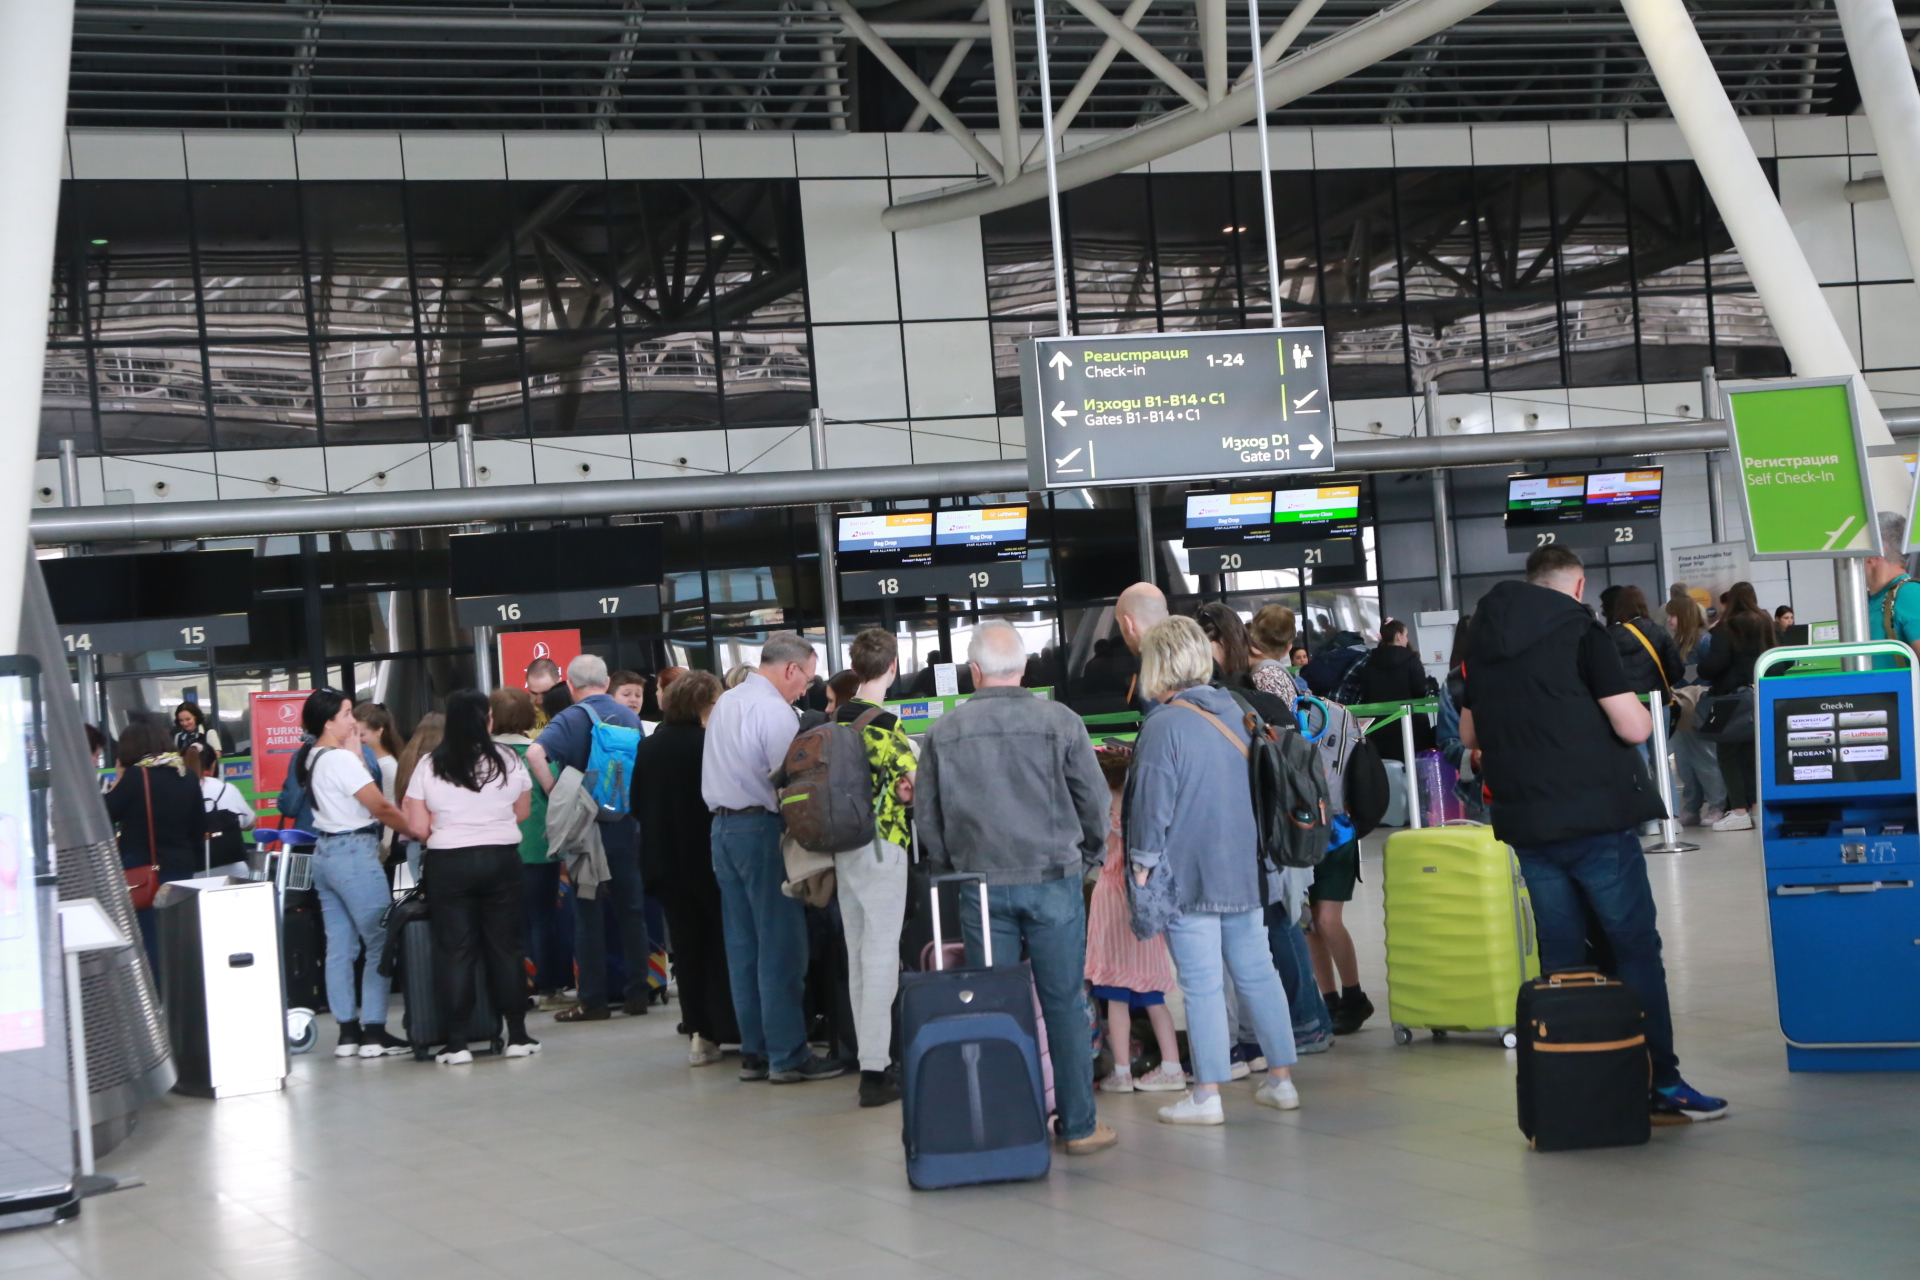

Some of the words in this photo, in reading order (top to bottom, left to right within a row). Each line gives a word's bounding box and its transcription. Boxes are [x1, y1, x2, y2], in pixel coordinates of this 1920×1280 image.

[1084, 349, 1189, 363] Регистрация
[1206, 353, 1245, 368] 1-24
[1085, 364, 1146, 378] Check-in
[1084, 398, 1141, 413] Изходи
[1085, 414, 1122, 426] Gates
[1222, 436, 1268, 451] Изход
[1272, 434, 1290, 446] D1
[1240, 450, 1271, 462] Gate
[1274, 449, 1290, 461] D1
[1744, 455, 1839, 469] Регистрация
[1748, 472, 1772, 486] Self
[1775, 471, 1835, 485] Check-In
[1614, 527, 1634, 543] 23
[1220, 553, 1242, 570] 20
[1304, 548, 1322, 564] 21
[877, 578, 899, 595] 18
[969, 572, 989, 588] 19
[497, 603, 521, 620] 16
[599, 597, 619, 613] 17
[64, 633, 92, 651] 14
[180, 627, 205, 644] 15
[1820, 702, 1853, 710] Check-In
[266, 726, 304, 736] TURKIS
[266, 735, 304, 745] AIRLIN
